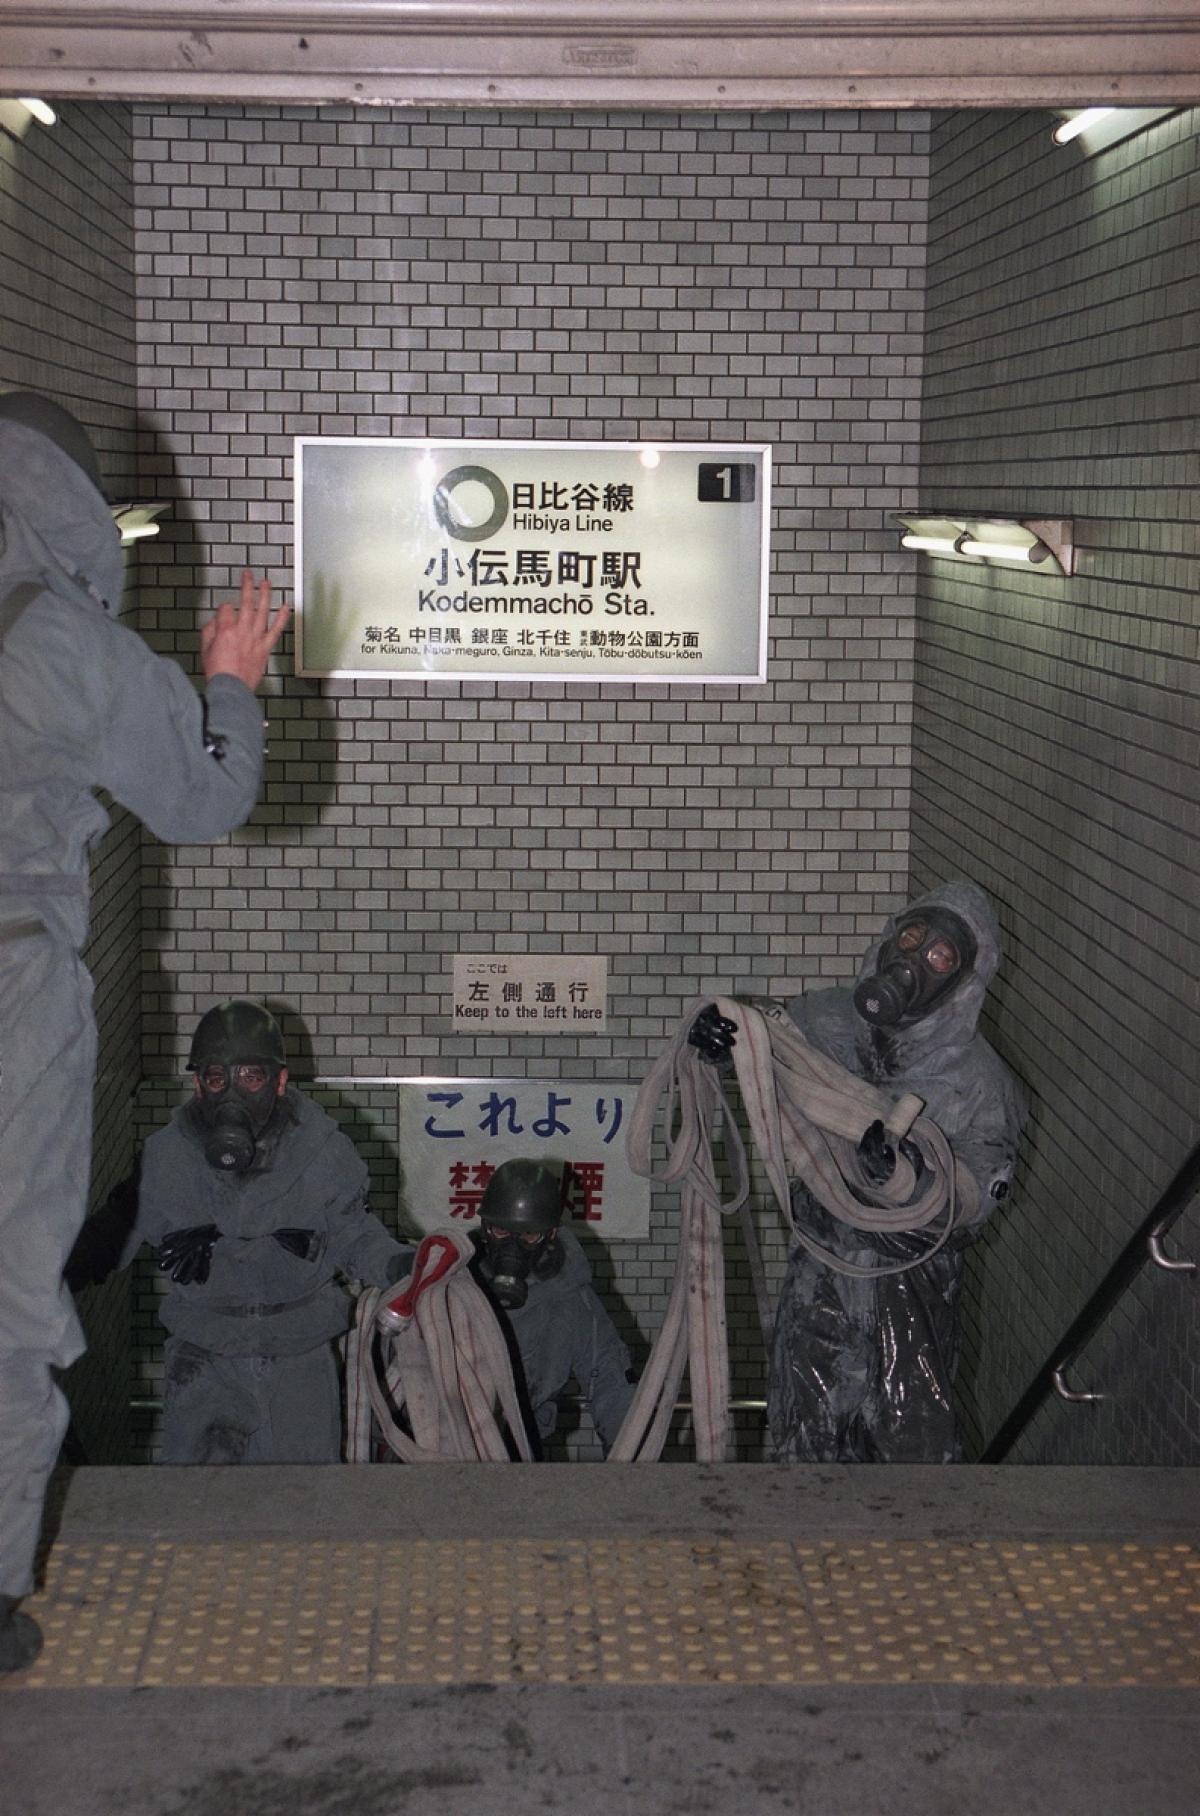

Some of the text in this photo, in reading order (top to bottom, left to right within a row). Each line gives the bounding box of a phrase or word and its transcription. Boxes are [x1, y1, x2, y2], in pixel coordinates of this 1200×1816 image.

[715, 467, 732, 499] 1
[512, 481, 634, 513] 日比谷線
[513, 514, 613, 534] Hibiya Line
[423, 549, 642, 590] 小伝馬町駅
[418, 590, 656, 616] Kodemmachō Sta.
[365, 625, 401, 643] 菊名
[409, 626, 462, 644] 中目黒
[471, 627, 509, 645] 銀座
[517, 629, 572, 646] 北千住
[361, 643, 376, 655] for
[380, 644, 420, 656] Kikuna,
[503, 646, 536, 658] Ginza,
[466, 963, 508, 974] ここでは
[468, 981, 588, 1003] 左側通行
[455, 1004, 602, 1020] Keep to the left here
[424, 1092, 623, 1144] これより
